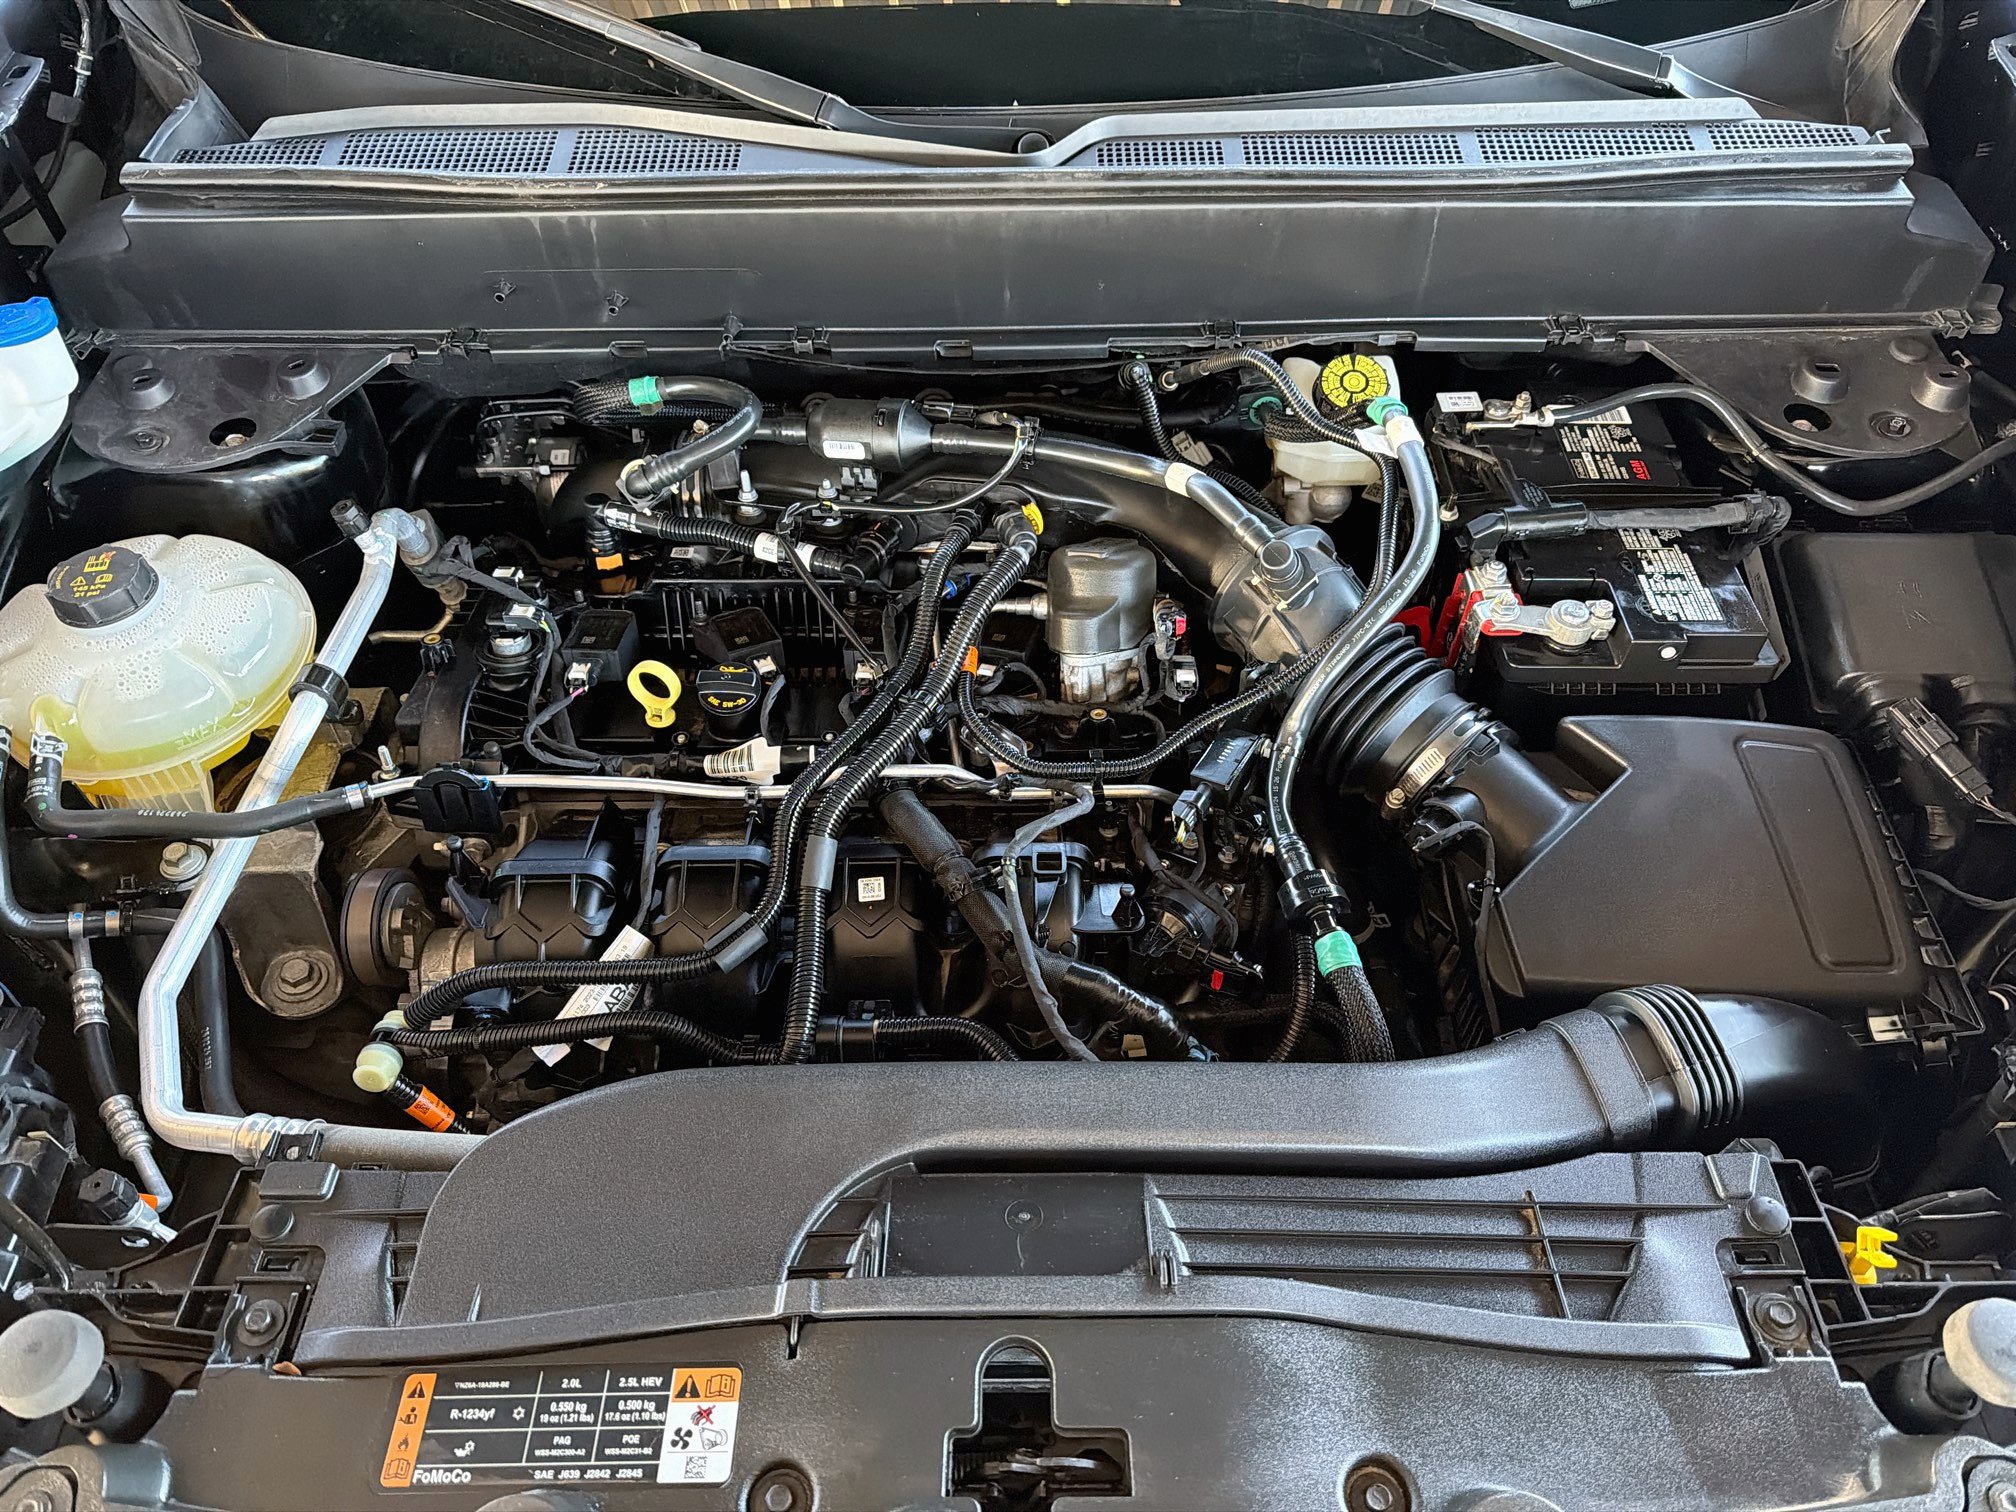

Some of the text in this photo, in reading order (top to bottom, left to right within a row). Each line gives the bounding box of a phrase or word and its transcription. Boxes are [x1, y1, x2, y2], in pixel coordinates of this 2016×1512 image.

[1630, 460, 1646, 480] AGM
[708, 696, 721, 706] SAE
[561, 1378, 582, 1388] 2.0L
[619, 1376, 663, 1388] 2.5L HEV
[550, 1402, 588, 1414] 0.550 kg
[618, 1400, 656, 1412] 0.500 kg
[450, 1408, 496, 1421] R-1234yf
[540, 1413, 595, 1424] 19 oz (1.21 lbs)
[605, 1411, 666, 1422] 17.6 oz (1.10 lbs)
[553, 1435, 572, 1445] PAG
[622, 1434, 641, 1444] POE
[412, 1469, 472, 1484] FoMoCo
[533, 1468, 643, 1479] SAE J639 J2842 J2845
